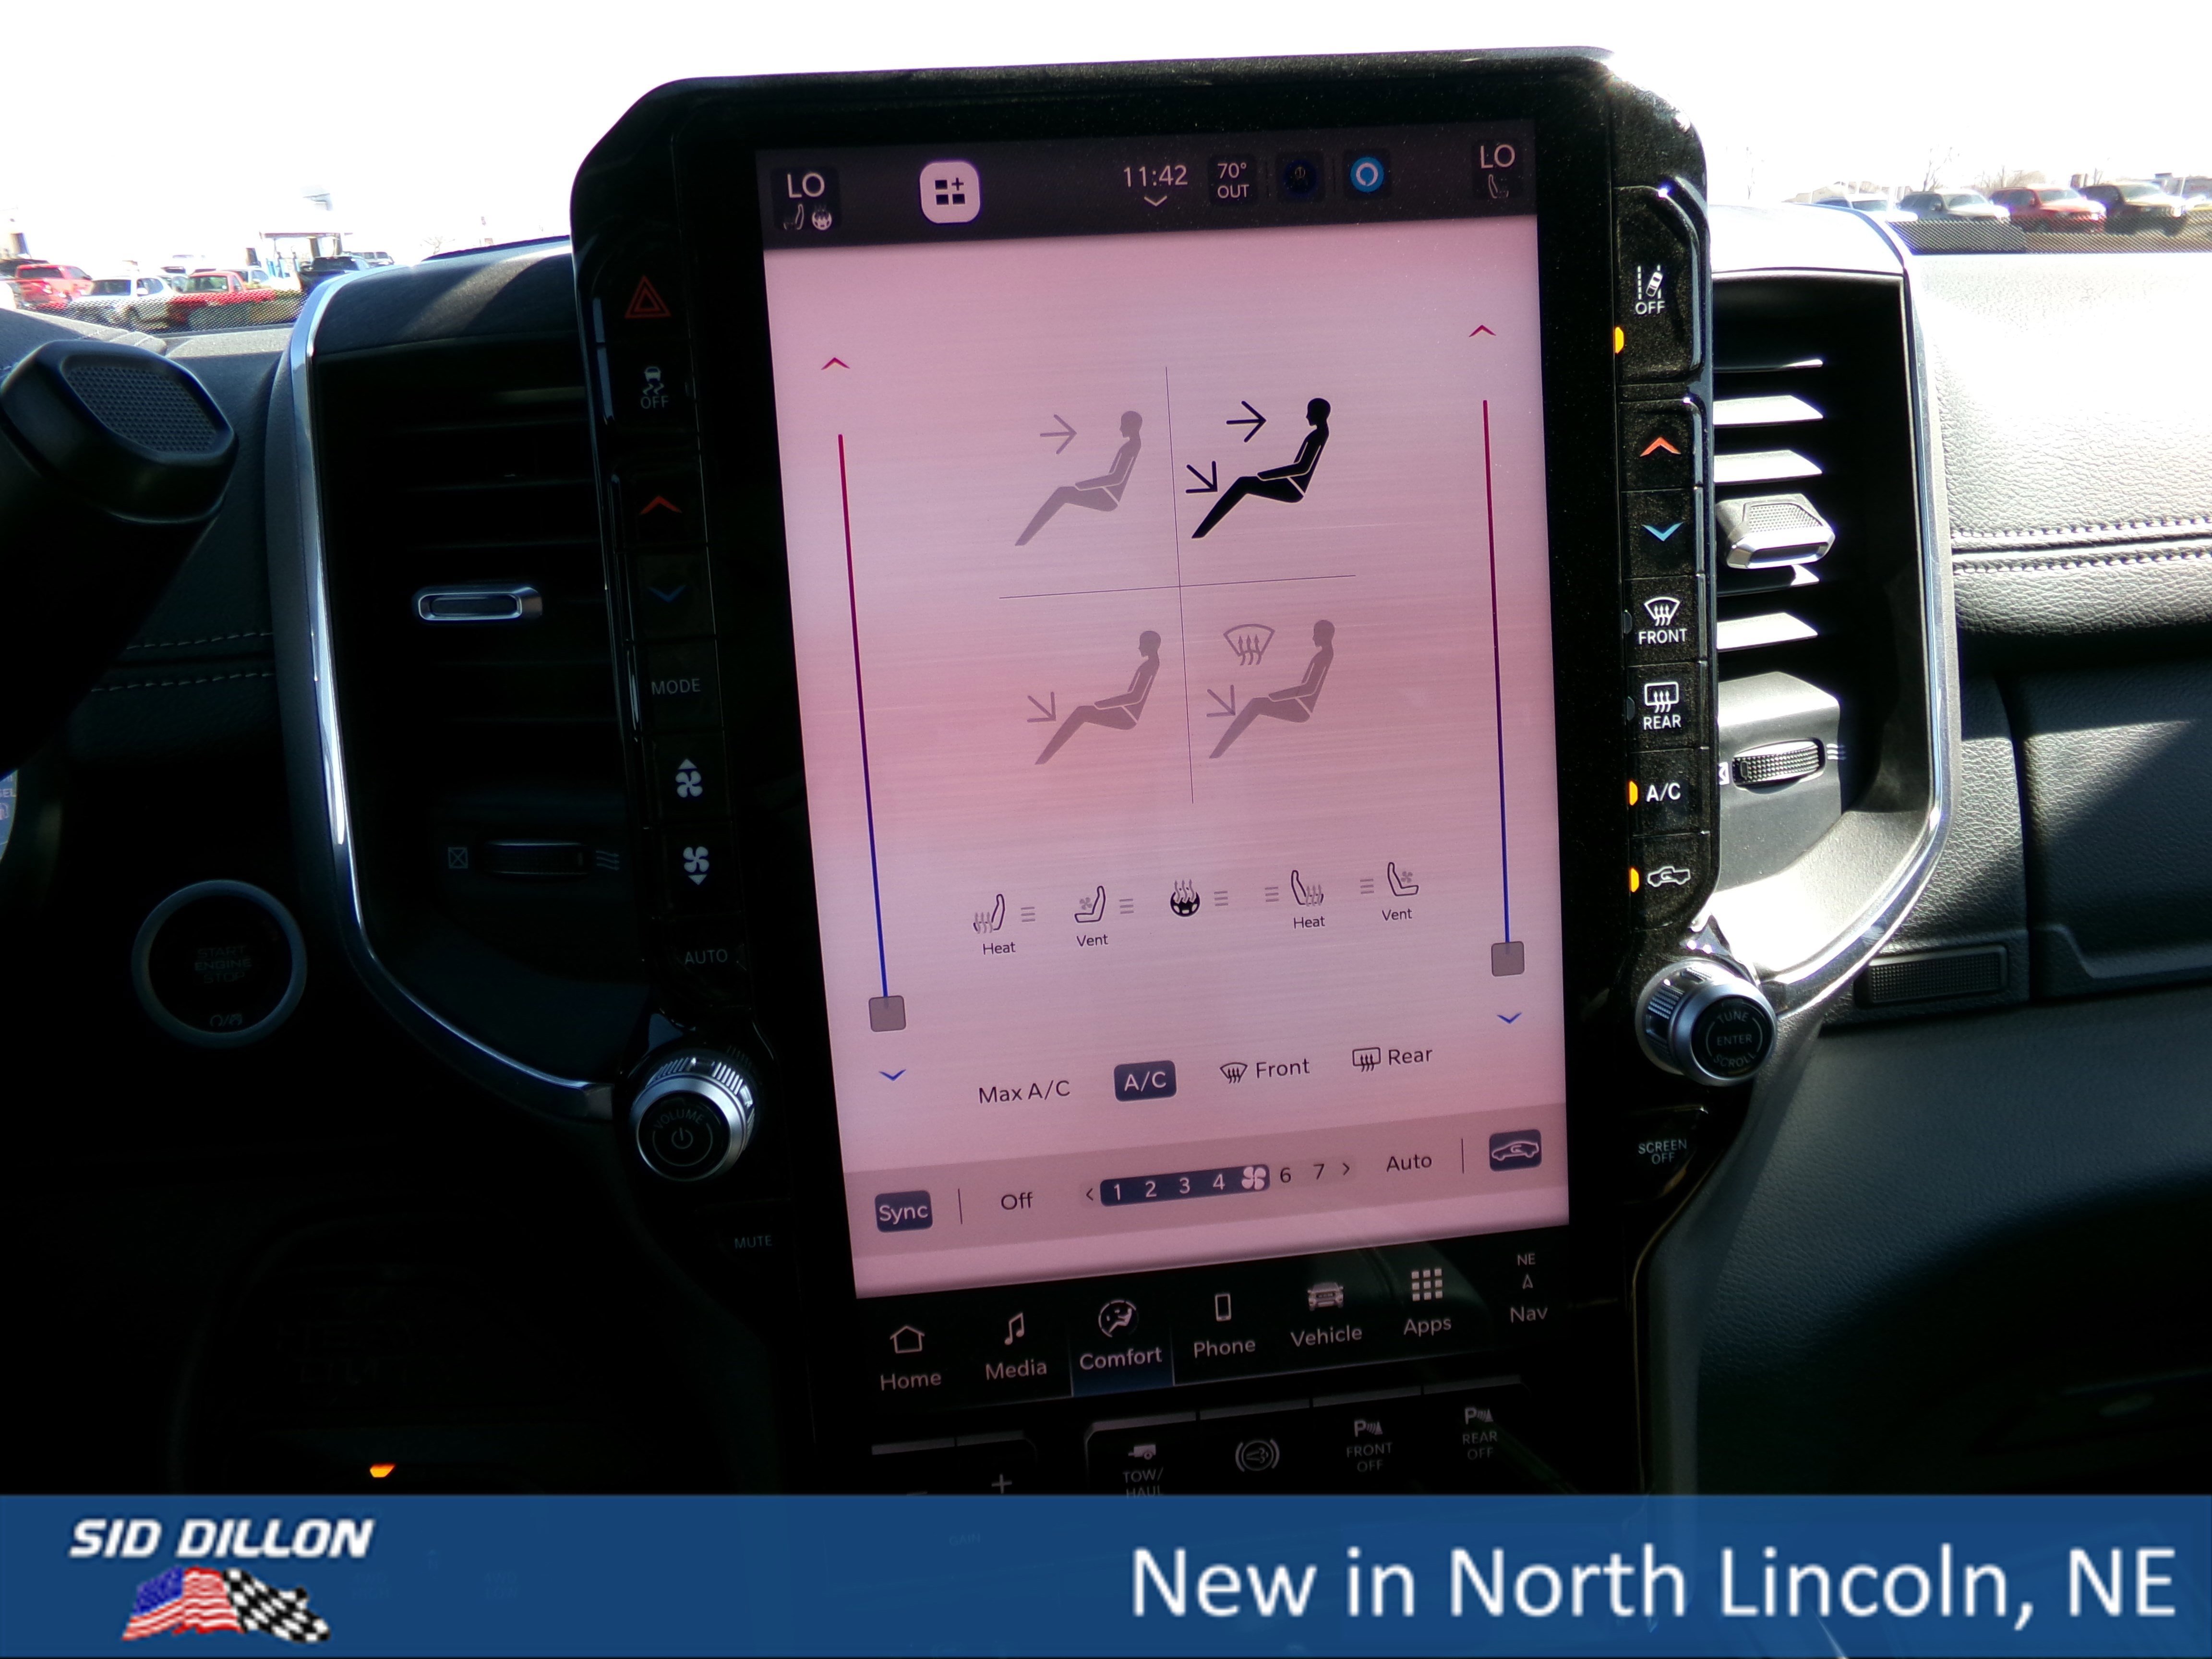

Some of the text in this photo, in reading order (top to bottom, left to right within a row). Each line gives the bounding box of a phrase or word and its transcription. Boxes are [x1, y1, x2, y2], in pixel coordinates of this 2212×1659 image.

[1480, 144, 1515, 168] LO
[1124, 165, 1188, 187] 11:42
[1218, 162, 1246, 179] 70°
[787, 173, 825, 198] LO
[1217, 184, 1249, 198] OUT
[1635, 301, 1664, 314] OFF
[640, 396, 668, 409] OFF
[1639, 628, 1687, 644] FRONT
[651, 678, 700, 695] MODE
[1643, 714, 1681, 730] REAR
[1647, 782, 1681, 802] A/C
[1294, 916, 1325, 928] Heat
[1382, 909, 1412, 921] Vent
[983, 942, 1015, 954] Heat
[1077, 934, 1108, 947] Vent
[685, 949, 728, 964] AUTO
[1717, 1010, 1749, 1022] TUNE
[1717, 1034, 1752, 1046] ENTER
[1389, 1049, 1432, 1065] Rear
[1713, 1053, 1756, 1068] SCROLL
[1257, 1058, 1310, 1078] Front
[1125, 1071, 1166, 1091] A/C
[979, 1080, 1070, 1103] Max A/C
[654, 1109, 705, 1130] VOLUME
[1638, 1139, 1686, 1154] SCREEN
[1387, 1154, 1431, 1172] Auto
[1652, 1152, 1674, 1164] OFF
[1114, 1164, 1324, 1200] 1 2 3 4 6 7
[1001, 1192, 1033, 1210] Off
[879, 1205, 927, 1225] Sync
[734, 1235, 772, 1249] MUTE
[1517, 1253, 1535, 1265] NE
[1510, 1306, 1548, 1322] Nav
[1291, 1325, 1362, 1346] Vehicle
[1404, 1319, 1451, 1336] Apps
[1194, 1340, 1255, 1358] Phone
[1080, 1347, 1162, 1370] Comfort
[986, 1359, 1046, 1380] Media
[880, 1373, 941, 1391] Home
[1463, 1430, 1497, 1444] REAR
[1346, 1442, 1392, 1458] FRONT
[1467, 1446, 1493, 1460] OFF
[1357, 1459, 1382, 1472] OFF
[1123, 1467, 1163, 1483] TOW/
